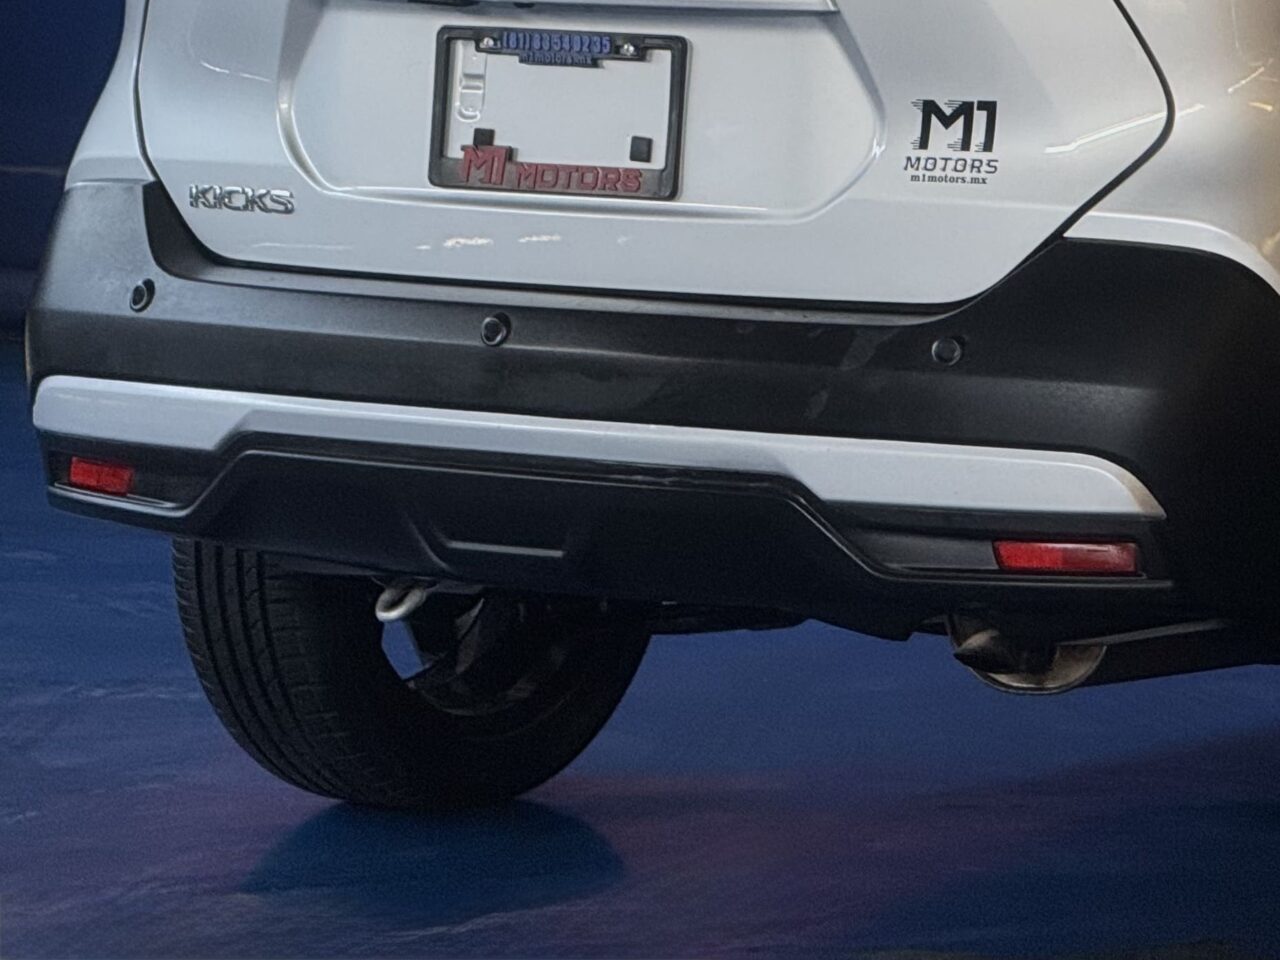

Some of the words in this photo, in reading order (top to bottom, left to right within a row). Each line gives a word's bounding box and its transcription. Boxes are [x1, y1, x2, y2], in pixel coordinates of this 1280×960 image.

[910, 98, 998, 153] M1
[516, 162, 643, 192] MOTORS
[904, 155, 1000, 175] MOTORS
[910, 173, 988, 185] m1motors.mx
[189, 184, 296, 214] KICKS
